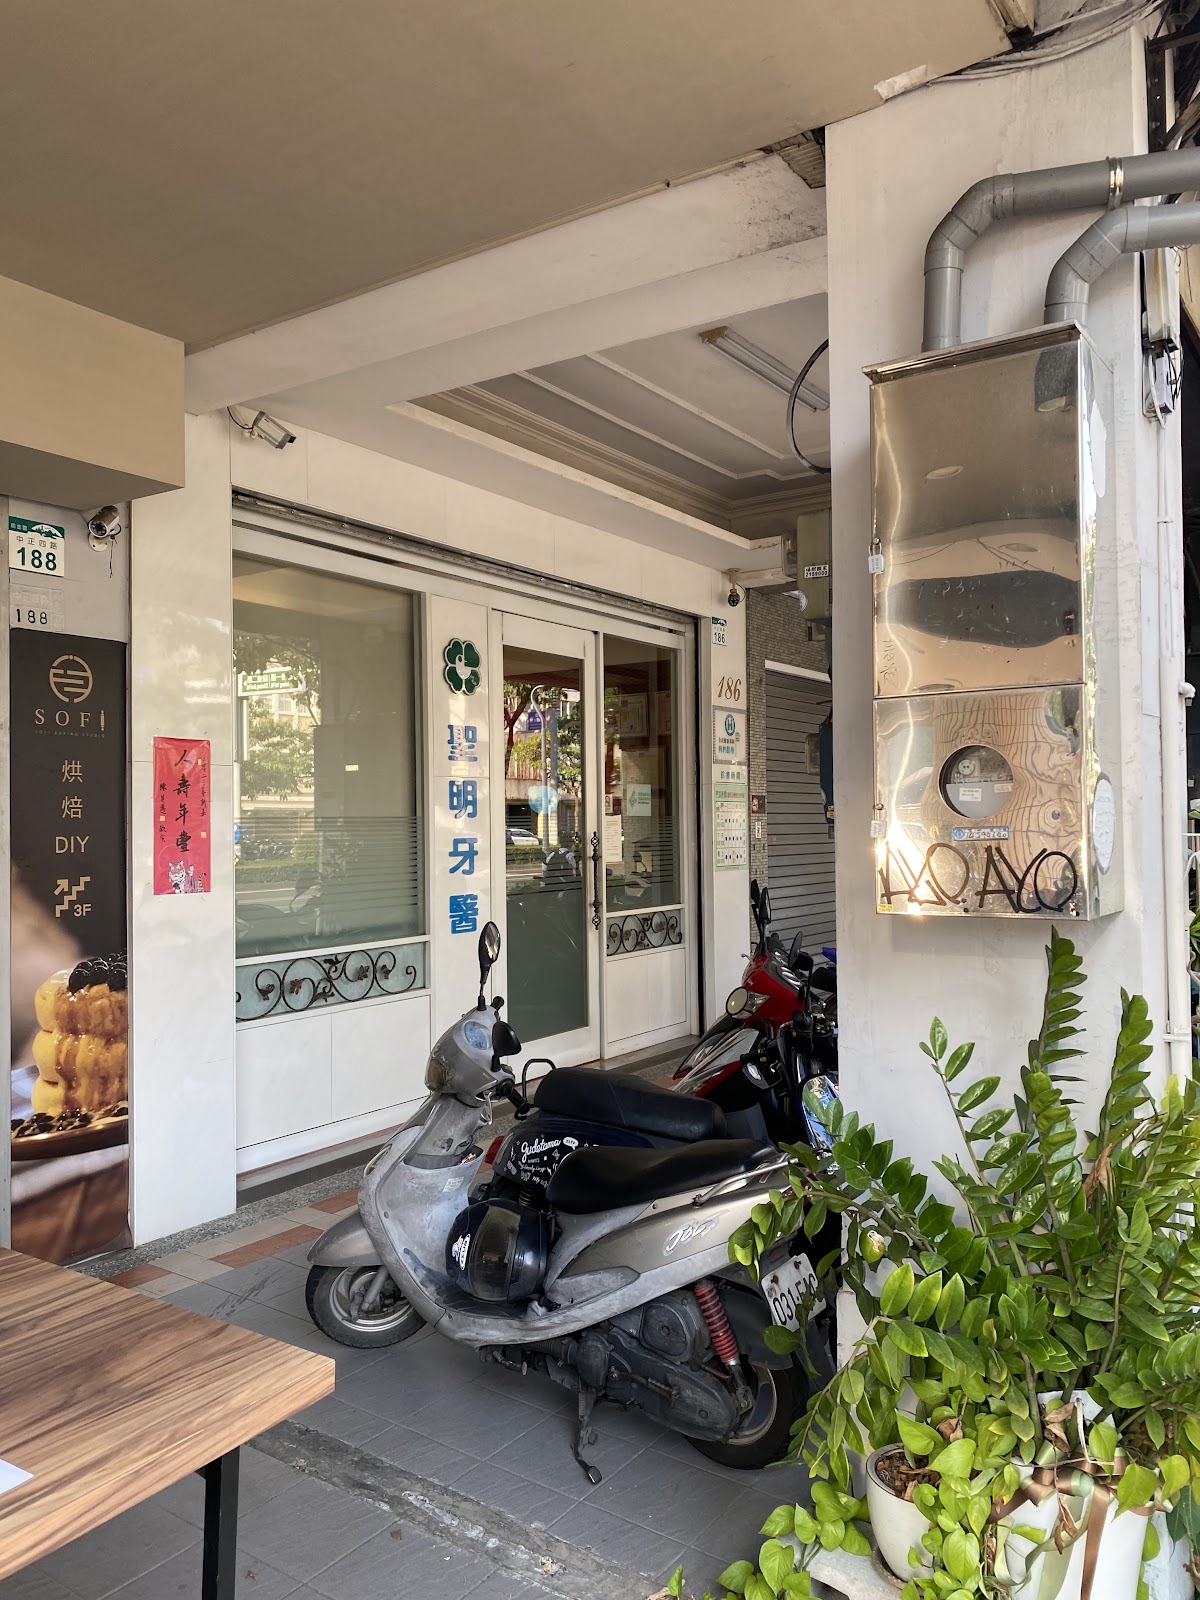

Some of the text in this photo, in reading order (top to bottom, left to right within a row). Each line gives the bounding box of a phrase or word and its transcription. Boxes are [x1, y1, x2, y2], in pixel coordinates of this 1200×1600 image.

[16, 535, 57, 550] 中正四路
[16, 546, 57, 571] 188
[16, 608, 48, 625] 188
[713, 632, 726, 644] 186
[717, 675, 742, 702] 186
[61, 759, 83, 819] 烘焙
[447, 724, 479, 935] 聖明牙醫
[55, 835, 90, 854] DIY
[73, 903, 92, 917] 3F
[521, 1138, 562, 1163] gudetama
